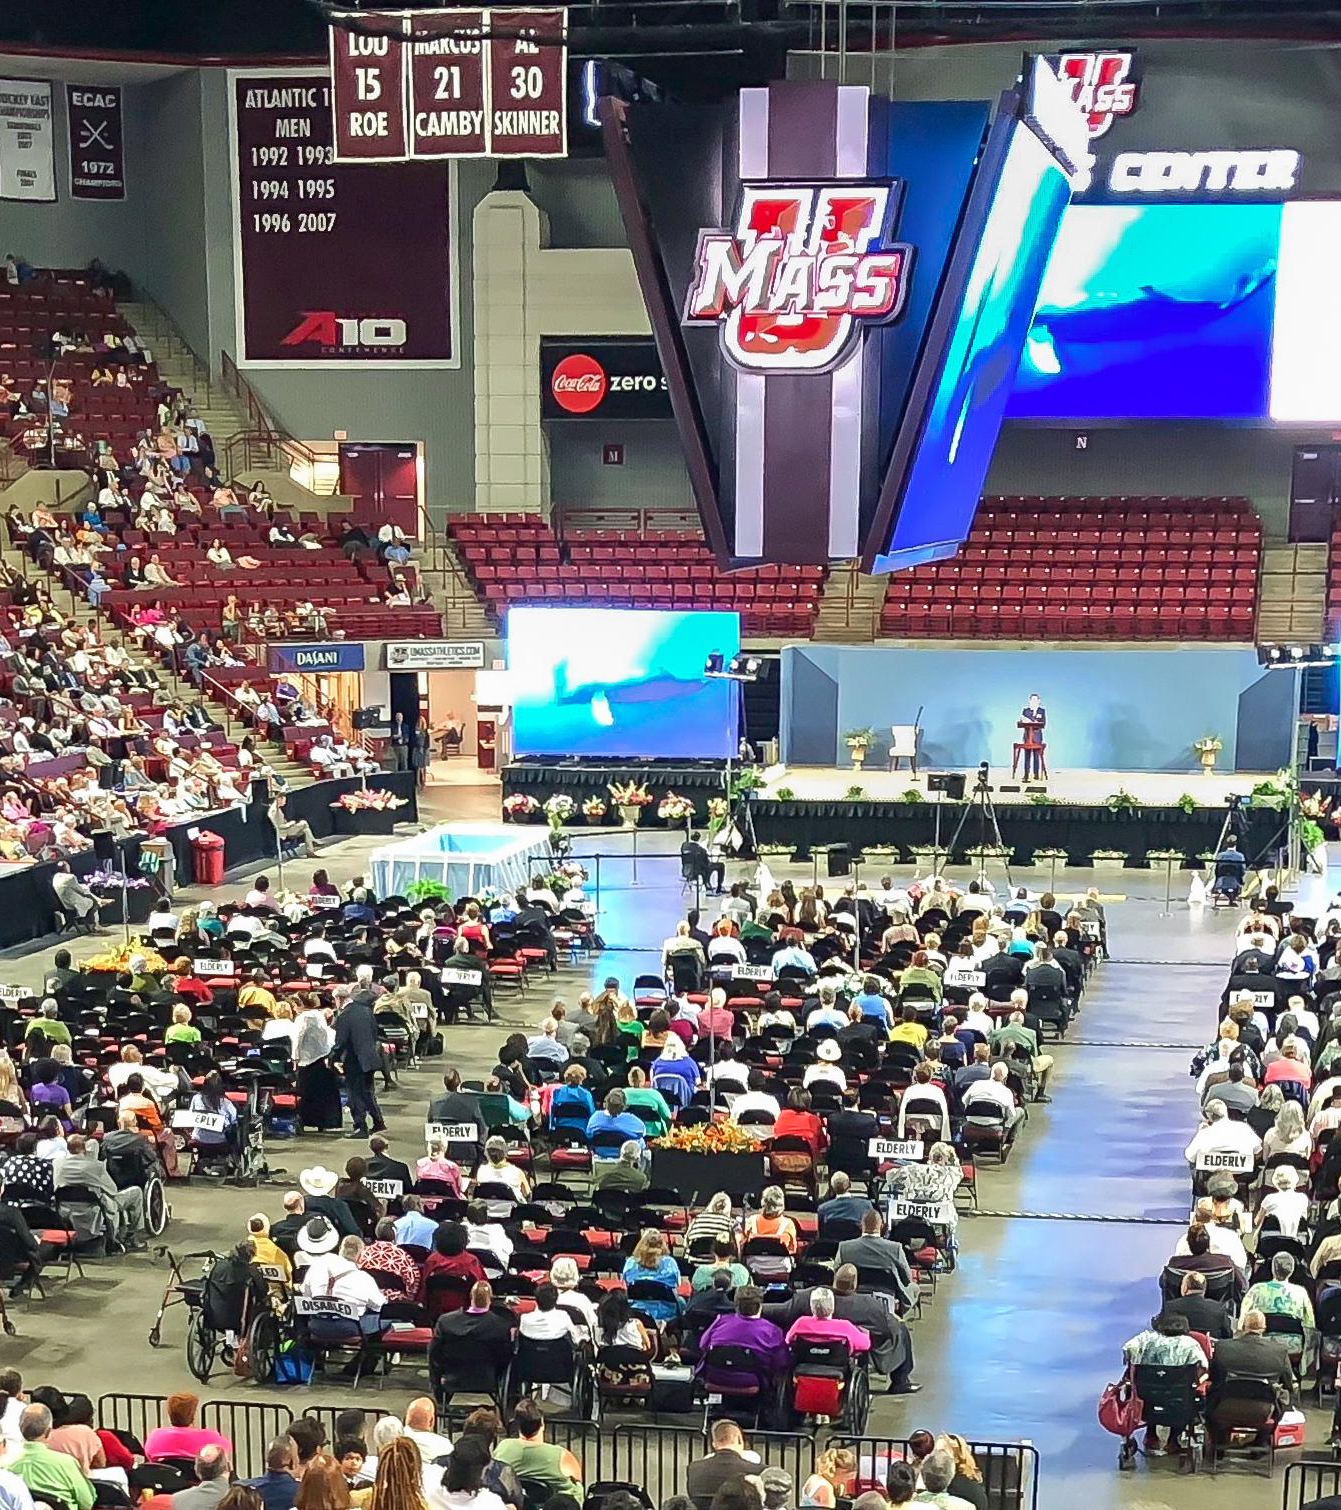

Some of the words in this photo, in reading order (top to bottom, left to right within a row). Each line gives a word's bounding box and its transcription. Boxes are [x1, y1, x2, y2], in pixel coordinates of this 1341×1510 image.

[348, 32, 388, 56] LOU
[356, 68, 382, 100] 15
[434, 66, 461, 100] 21
[510, 66, 543, 99] 30
[72, 92, 117, 108] ECAC
[245, 88, 317, 108] ATLANTIC
[275, 119, 311, 138] MEN
[350, 112, 388, 136] ROE
[415, 111, 483, 137] CAMBY
[494, 111, 560, 135] SKINNER
[252, 148, 288, 167] 1992
[297, 146, 333, 165] 1993
[81, 160, 115, 175] 1972
[252, 180, 289, 200] 1994
[297, 179, 335, 199] 1995
[253, 213, 291, 233] 1996
[298, 213, 336, 232] 2007
[610, 375, 656, 391] zero
[1076, 436, 1088, 449] N
[608, 451, 618, 462] M
[296, 651, 338, 666] DASANI
[738, 967, 767, 976] ELDERLY
[0, 989, 28, 998] ELDERLY
[876, 1142, 916, 1155] ELDERLY
[1203, 1154, 1247, 1168] ELDERLY
[896, 1203, 941, 1219] ELDERLY
[302, 1299, 352, 1316] DISABLED
